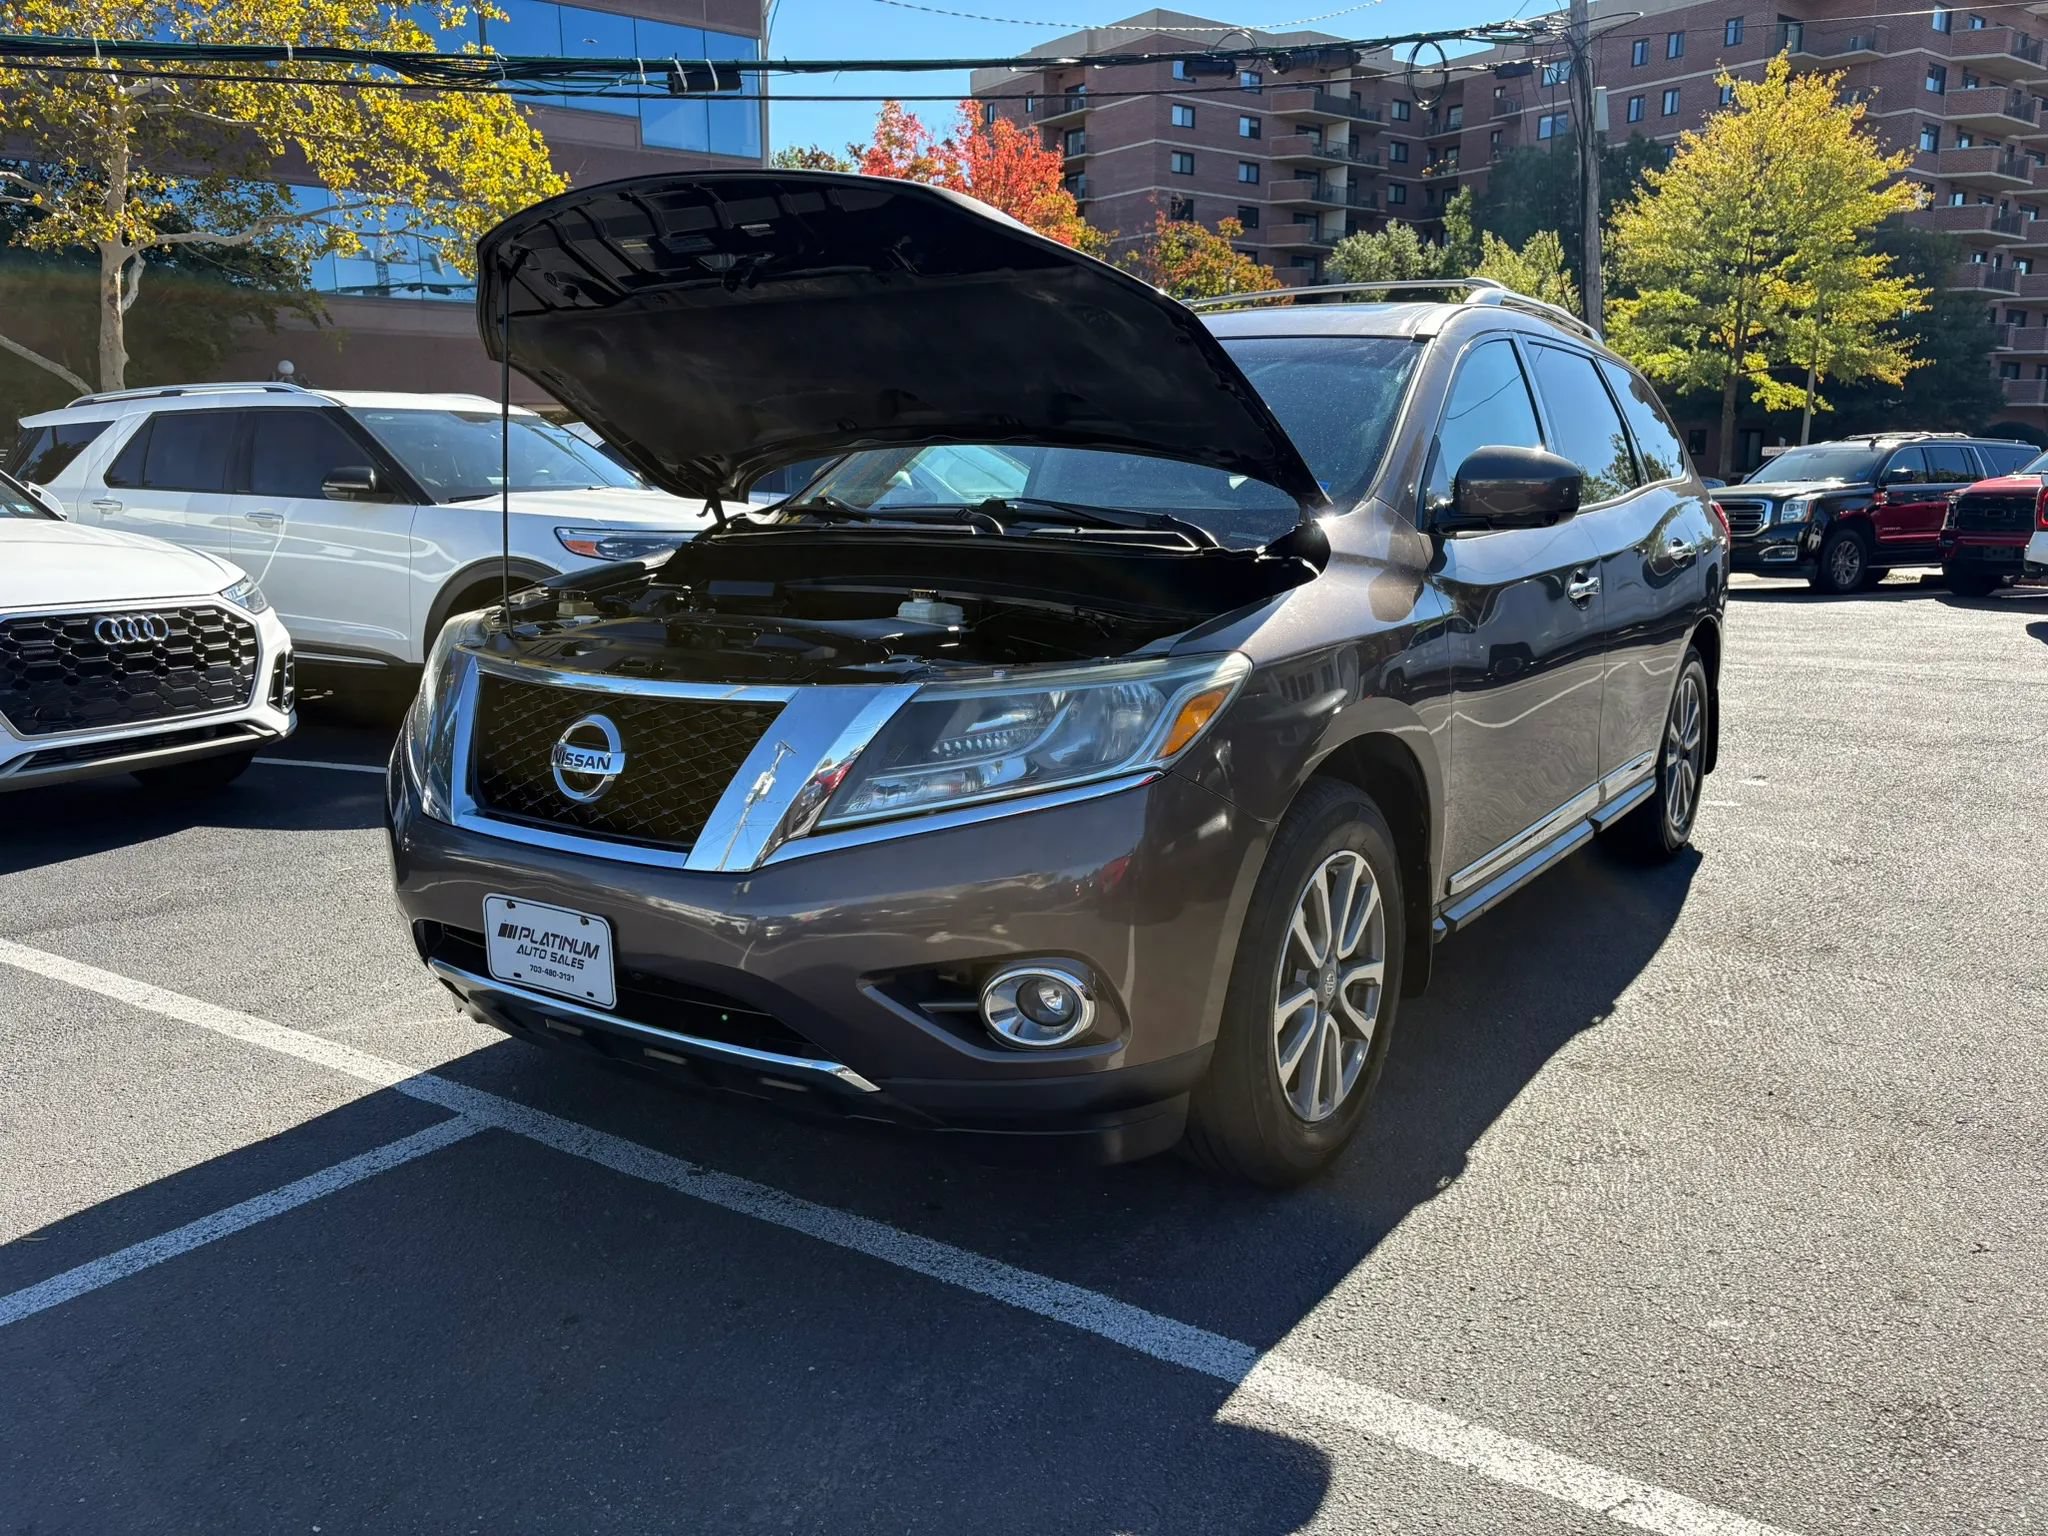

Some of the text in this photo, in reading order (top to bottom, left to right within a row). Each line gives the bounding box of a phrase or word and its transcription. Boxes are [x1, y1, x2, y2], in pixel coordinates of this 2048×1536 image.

[552, 748, 612, 771] NISSAN
[517, 927, 600, 960] PLATINUM
[516, 944, 585, 970] AUTO SALES
[529, 964, 575, 982] 703-480-3131
